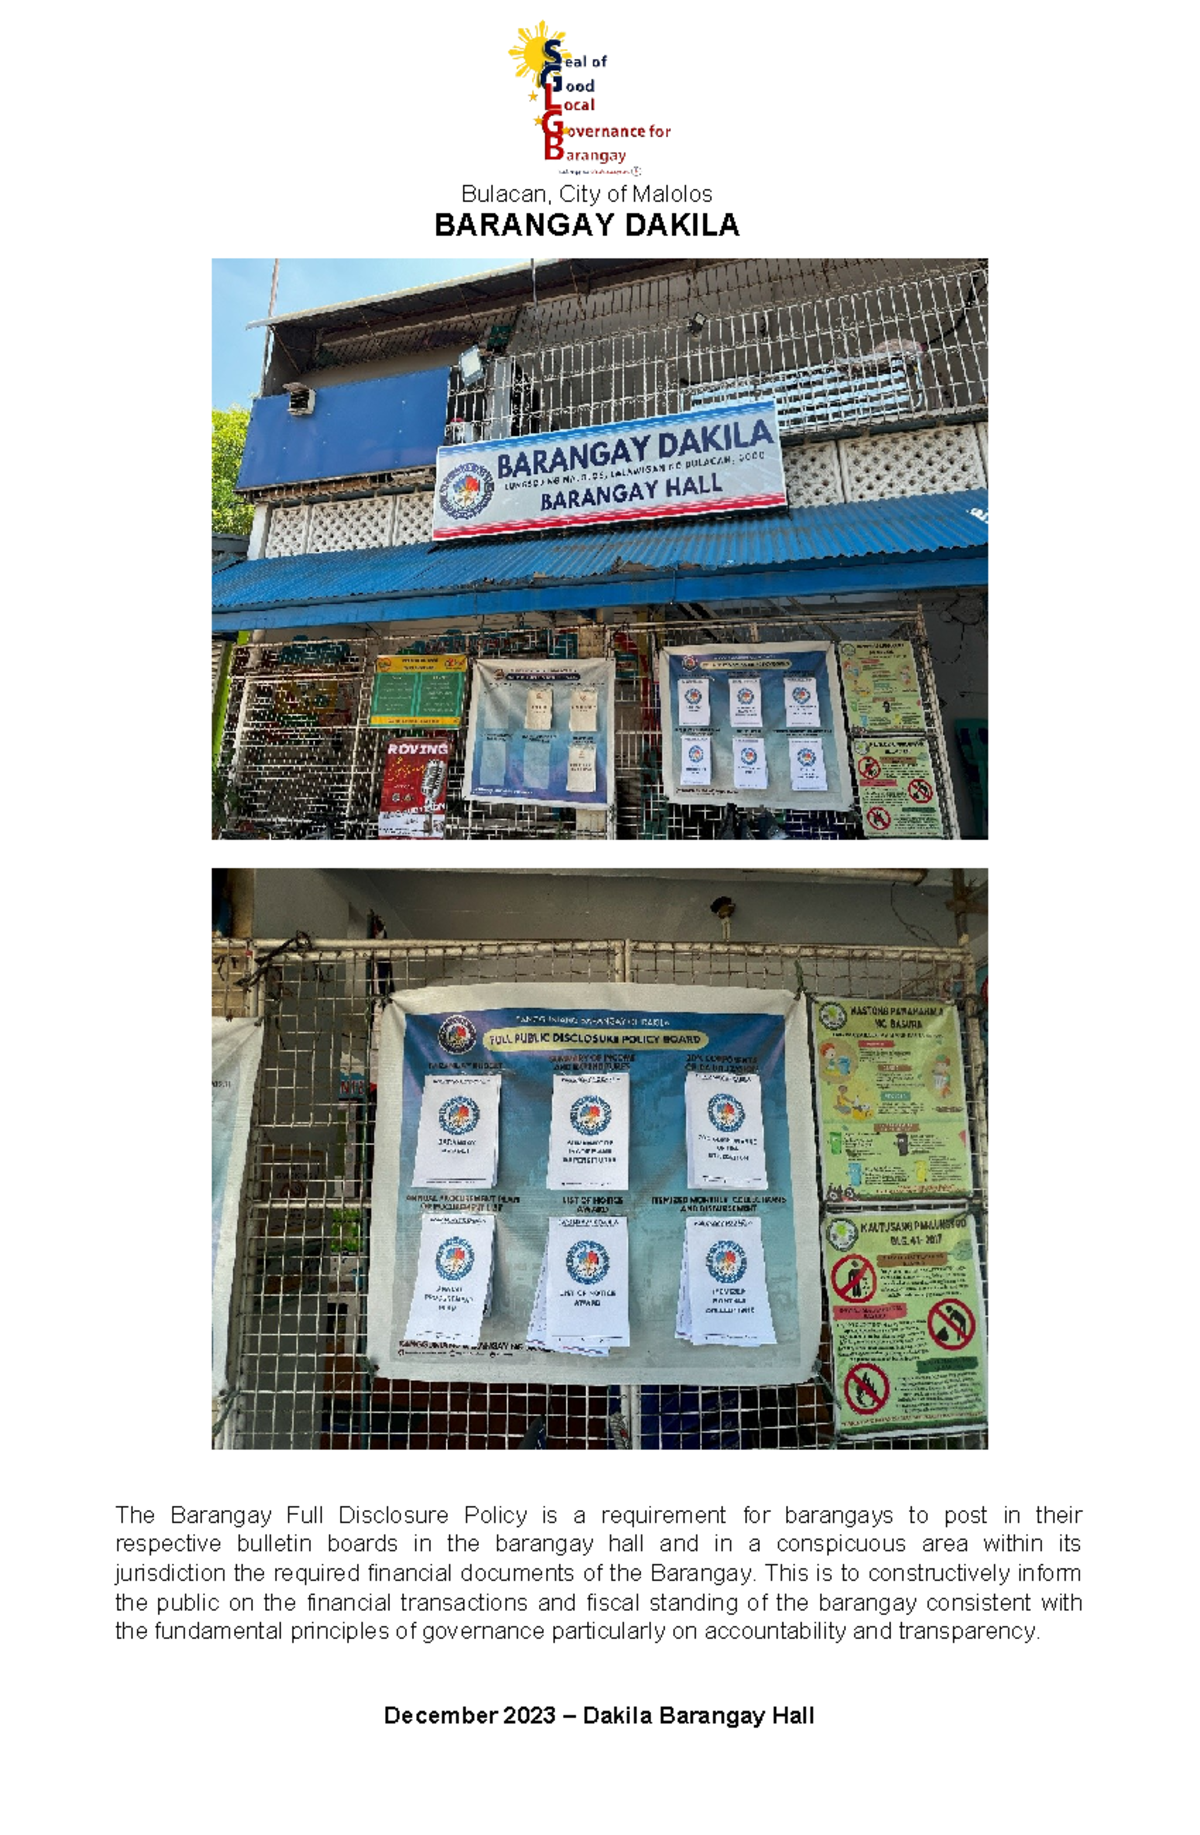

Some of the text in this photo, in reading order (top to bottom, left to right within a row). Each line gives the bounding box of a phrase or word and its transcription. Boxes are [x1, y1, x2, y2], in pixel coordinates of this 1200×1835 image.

[542, 39, 607, 67] Seal of
[544, 83, 595, 111] Local
[541, 109, 671, 137] Governance for
[544, 134, 626, 164] Barangay
[463, 184, 712, 207] Bulacan, City of Malolos
[436, 213, 740, 236] BARANGAY DAKILA
[498, 418, 775, 479] BARANGAY DAKILA
[540, 472, 723, 511] BARANGAY HALL
[388, 744, 448, 755] ROVING
[490, 1032, 701, 1045] FULL PUBLIC DISCLOSURE POLICY BOARD
[115, 1506, 1083, 1528] The Barangay Full Disclosure Policy is a requirement for barangays to post in their
[117, 1534, 1080, 1556] respective bulletin boards in the barangay hall and in a conspicuous area within its
[114, 1564, 1080, 1586] jurisdiction the required financial documents of the Barangay. This is to constructively inform
[115, 1593, 1082, 1615] the public on the financial transactions and fiscal standing of the barangay consistent with
[115, 1621, 1039, 1643] the fundamental principles of governance particularly on accountability and transparency.
[385, 1706, 499, 1724] December
[504, 1706, 555, 1724] 2023
[584, 1706, 653, 1724] Dakila
[660, 1706, 766, 1728] Barangay
[773, 1706, 814, 1724] Hall
